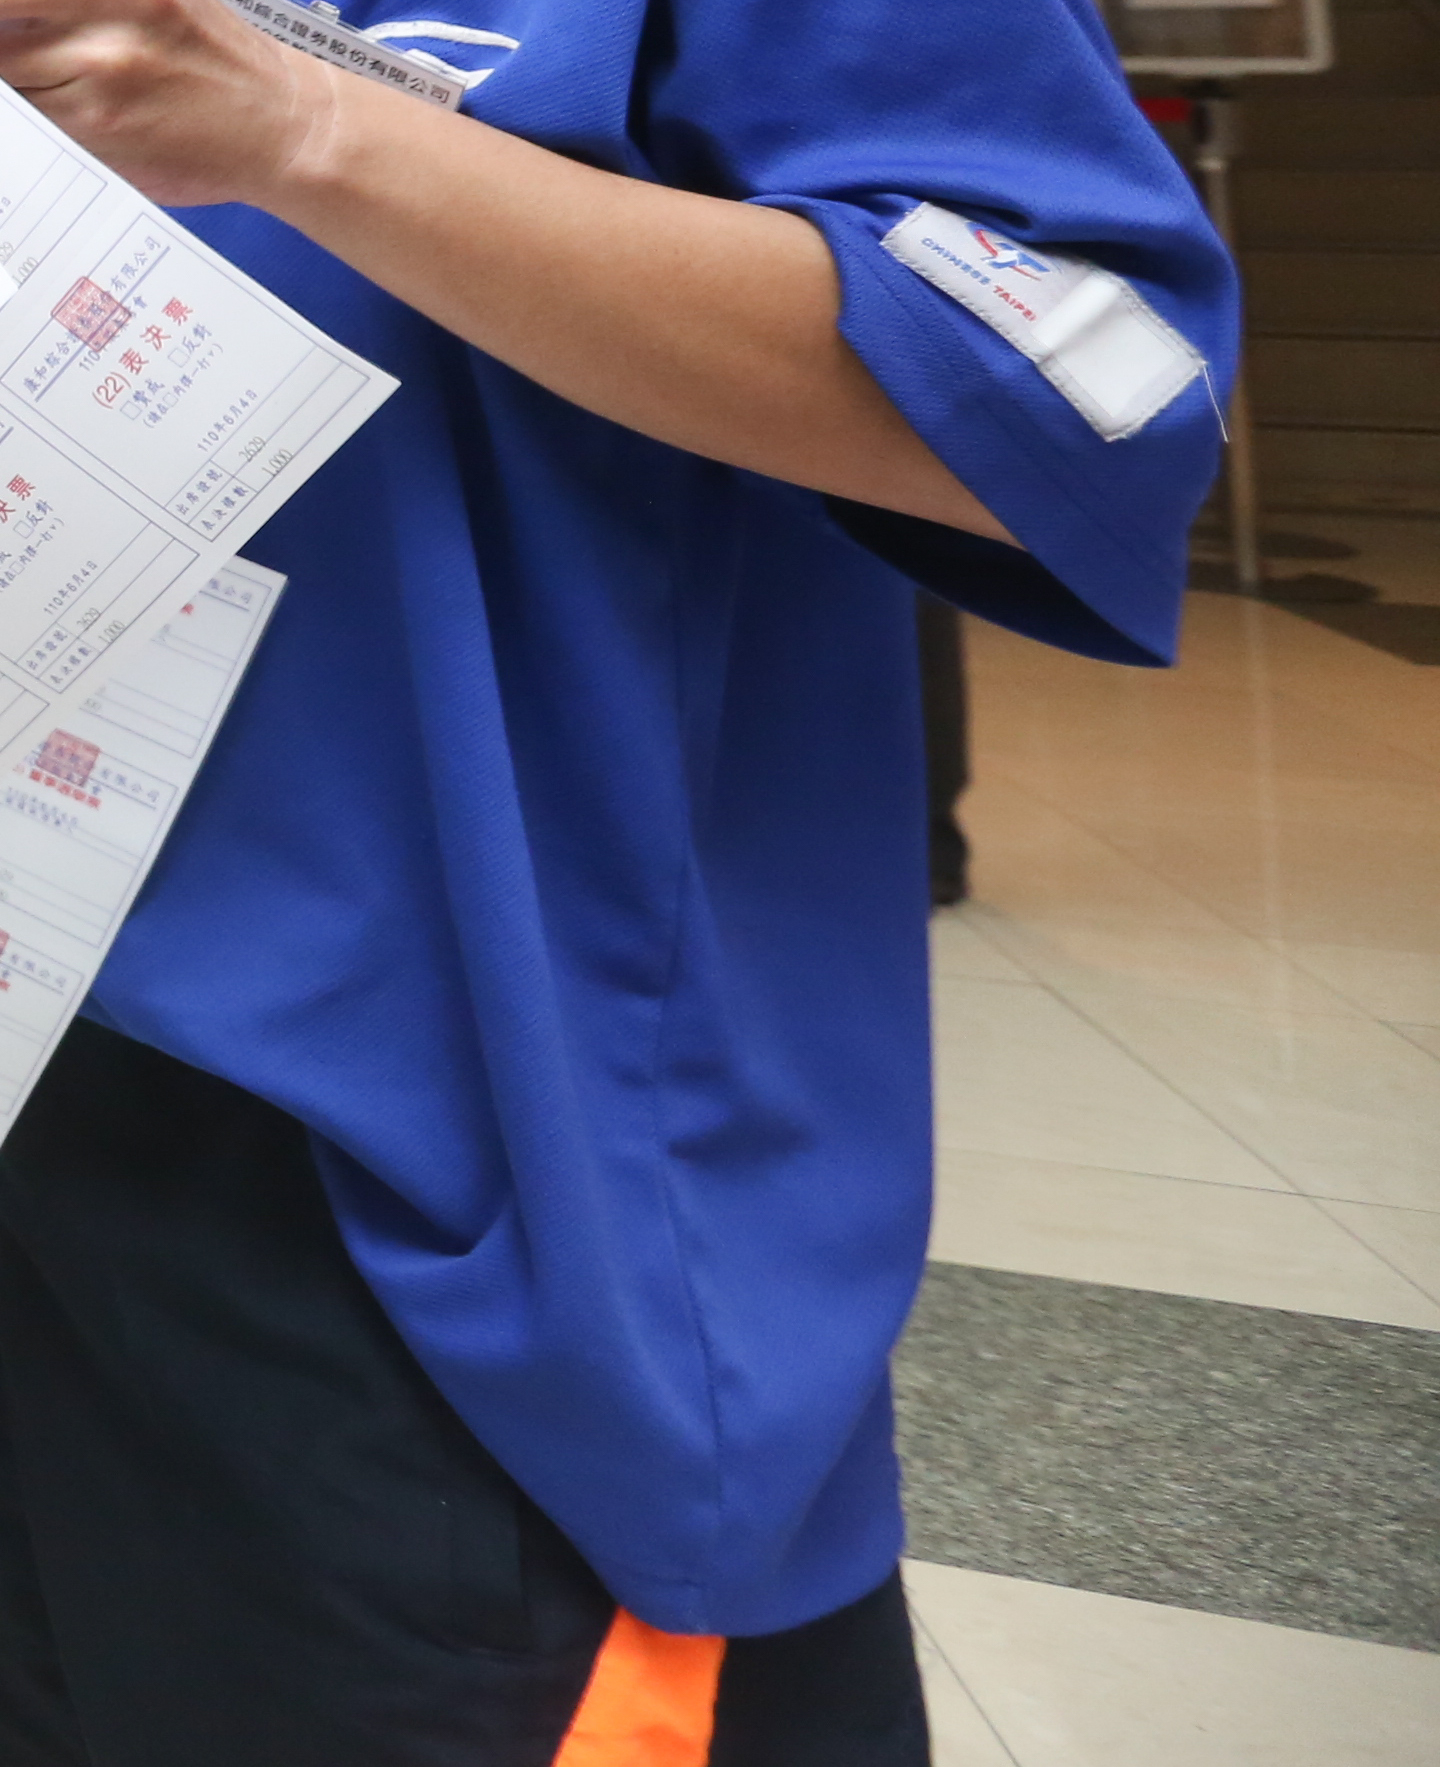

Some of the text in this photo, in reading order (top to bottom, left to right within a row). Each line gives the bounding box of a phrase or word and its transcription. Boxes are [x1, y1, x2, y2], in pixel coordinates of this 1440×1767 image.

[920, 237, 1037, 322] CHINESE TAIPEI
[92, 297, 193, 409] (22)表決票
[197, 390, 258, 453] 110年6月4日
[239, 435, 266, 464] 2629
[262, 448, 293, 478] 1,000
